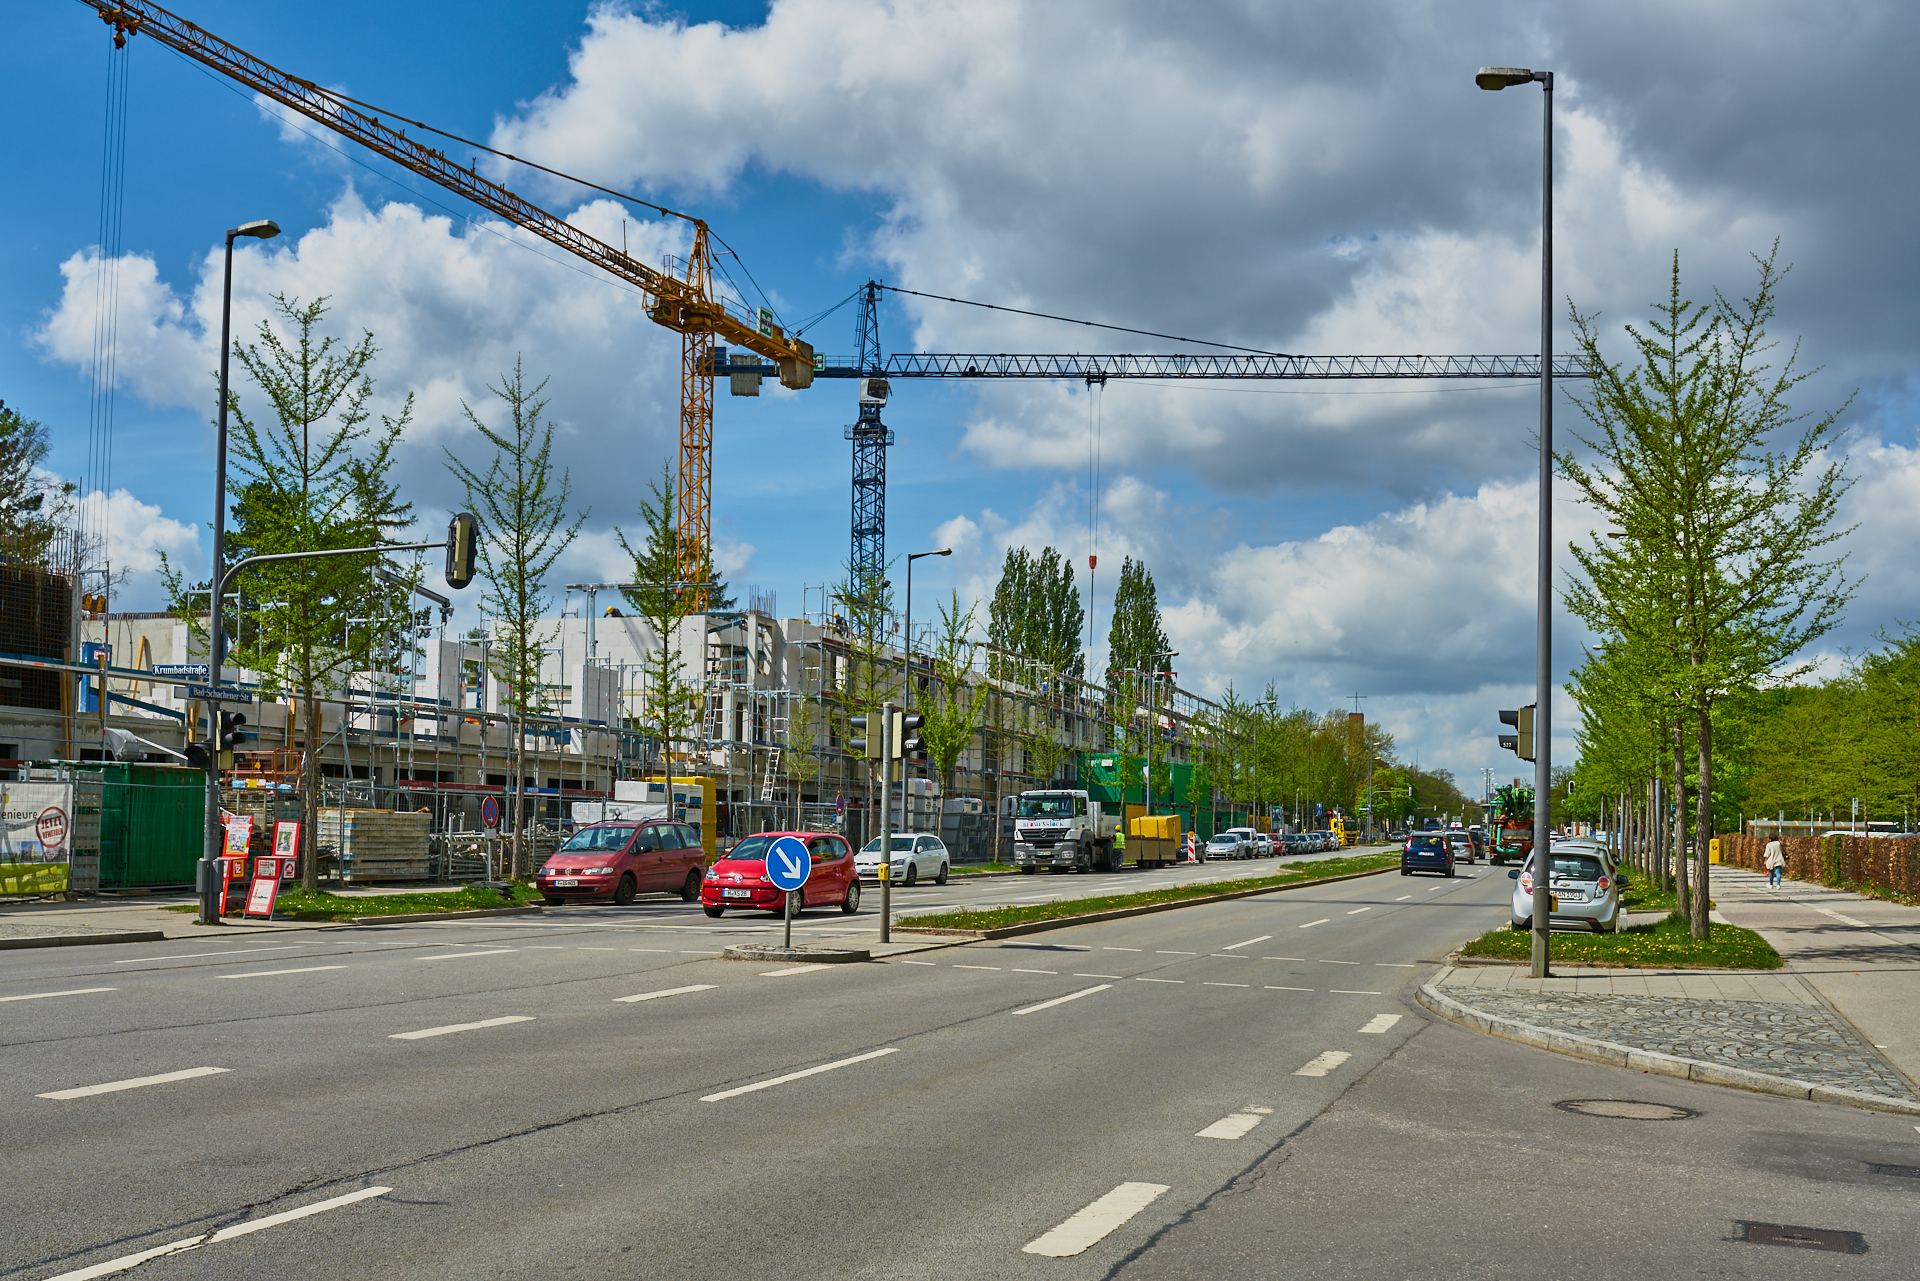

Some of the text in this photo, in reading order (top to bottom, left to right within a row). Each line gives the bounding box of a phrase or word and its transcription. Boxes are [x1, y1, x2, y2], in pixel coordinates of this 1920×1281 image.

[154, 665, 207, 675] Krumbadstraße
[193, 688, 250, 701] Bad-Schachener-Str.
[0, 809, 38, 820] enieure
[41, 815, 62, 829] JETZT
